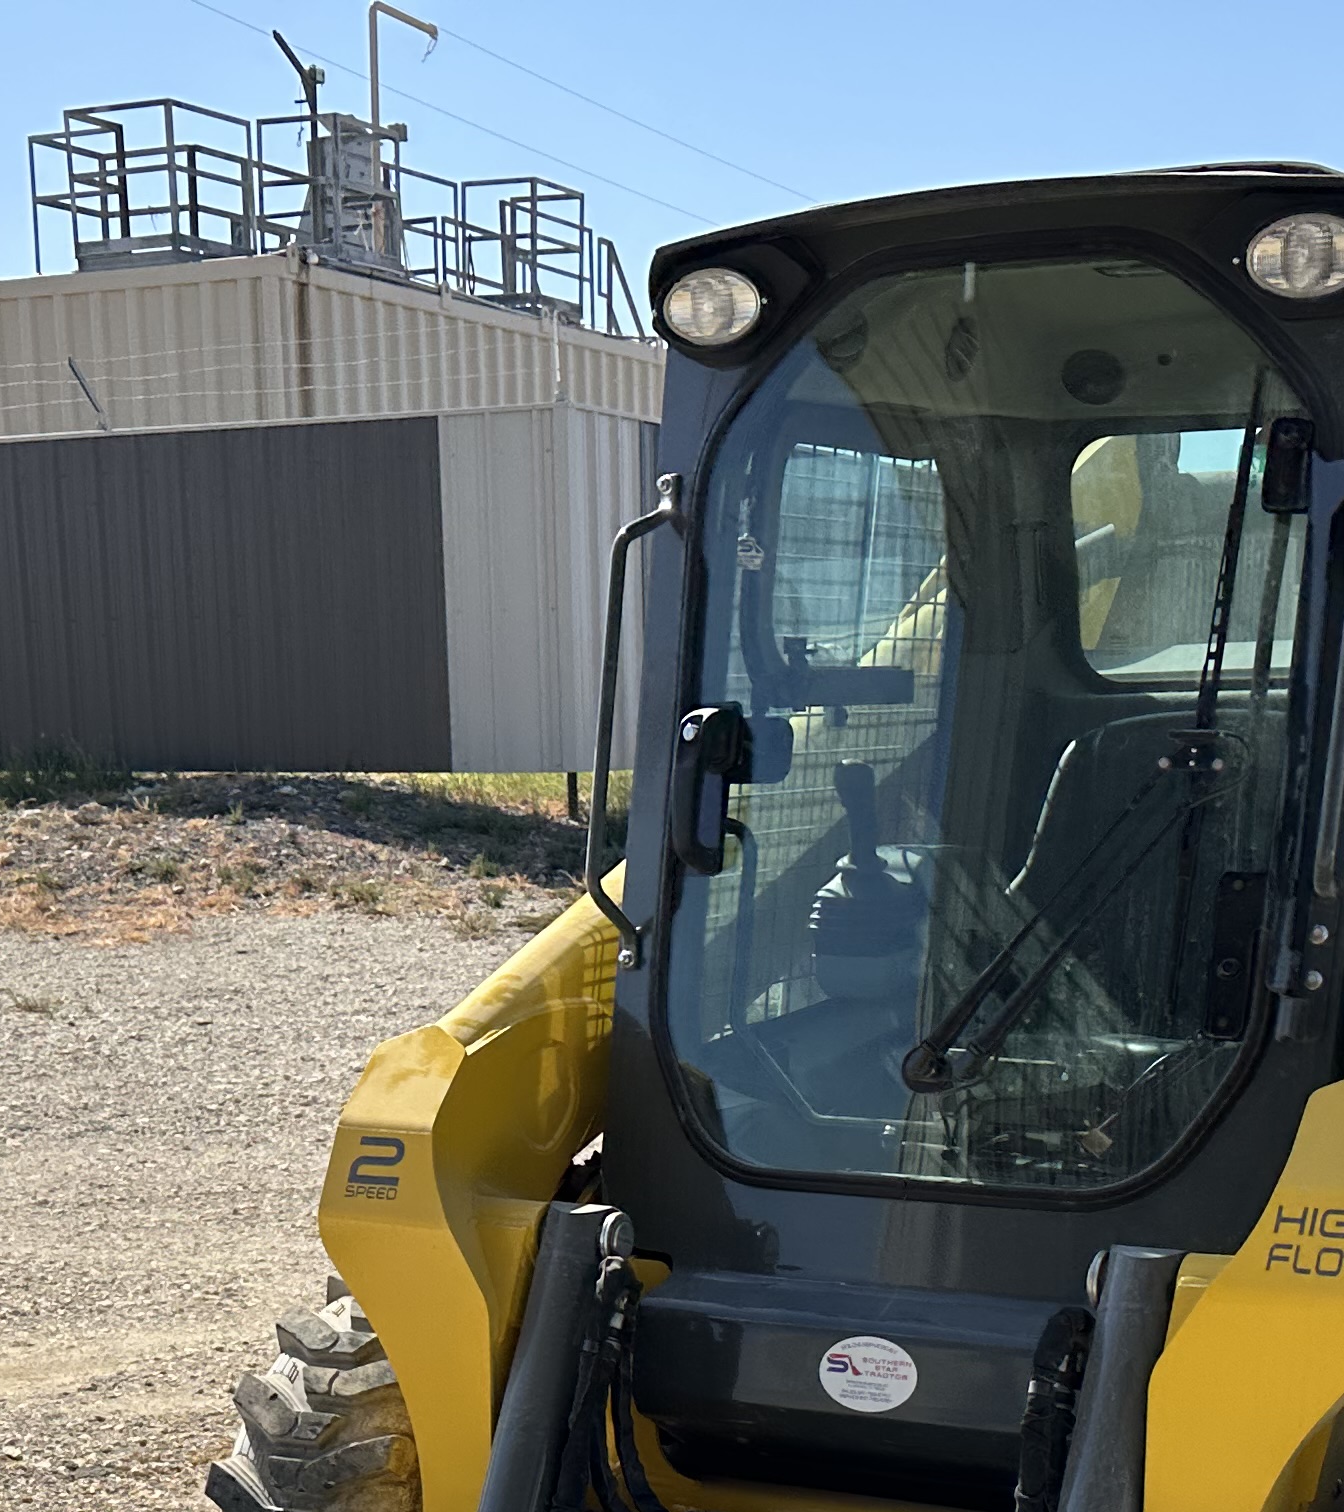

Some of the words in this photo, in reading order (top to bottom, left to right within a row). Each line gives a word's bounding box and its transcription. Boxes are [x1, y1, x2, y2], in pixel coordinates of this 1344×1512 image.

[348, 1136, 405, 1186] 2
[344, 1184, 398, 1201] SPEED
[862, 1357, 912, 1368] SOUTHERN
